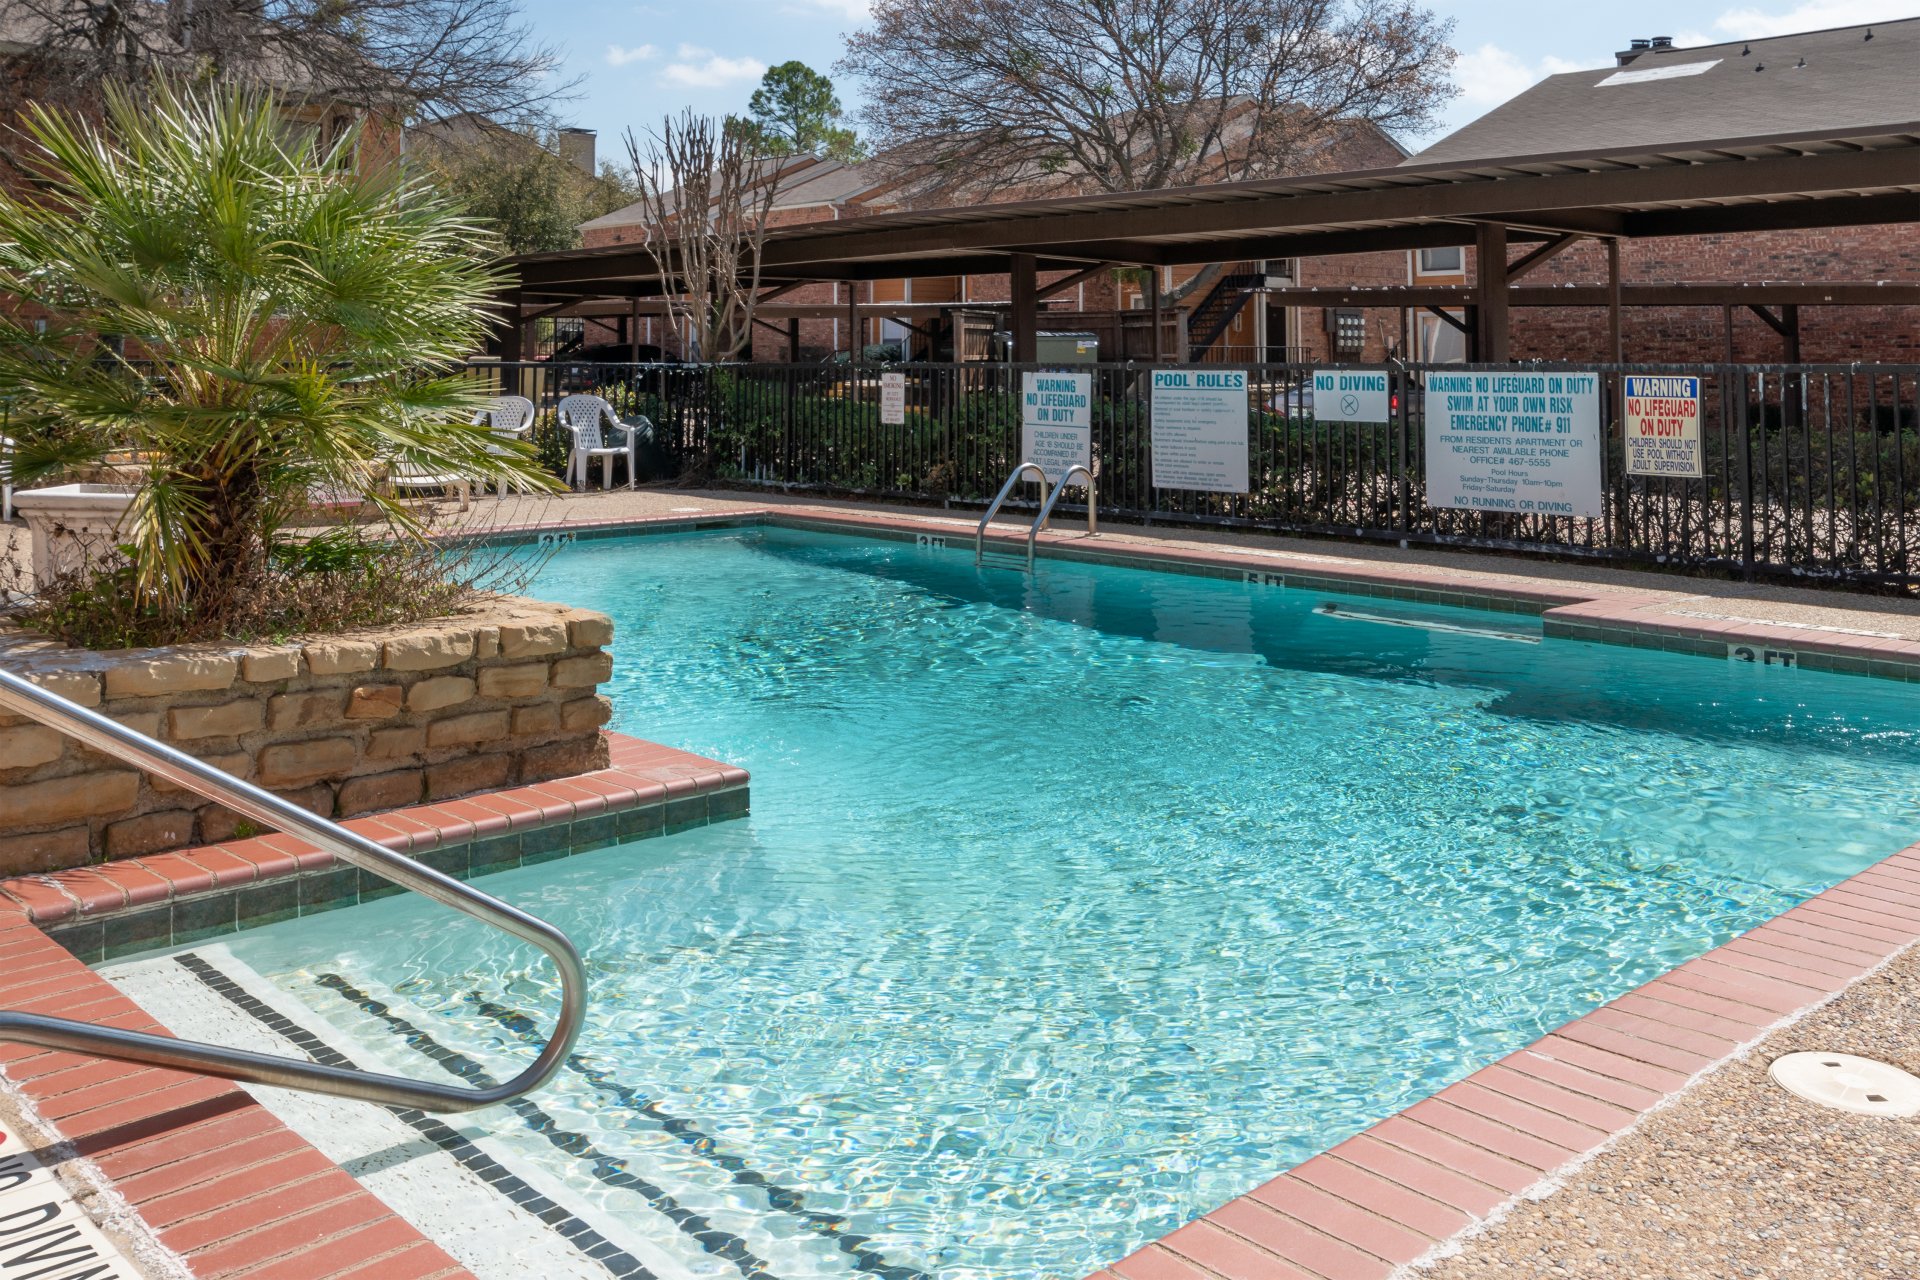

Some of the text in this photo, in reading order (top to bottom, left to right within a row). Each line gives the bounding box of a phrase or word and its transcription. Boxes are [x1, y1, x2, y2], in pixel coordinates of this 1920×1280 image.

[1036, 379, 1076, 392] WARNING
[1155, 374, 1243, 388] POOL RULES
[1316, 376, 1385, 391] NO DIVING
[1429, 376, 1594, 394] WARNING NO LIFEGUARD ON DUTY
[1632, 378, 1691, 398] WARNING
[1026, 392, 1086, 408] NO LIFEGUARD
[1448, 396, 1574, 414] SWIM AT YOUR OWN RISK
[1037, 408, 1074, 422] ON DUTY
[1628, 399, 1696, 418] NO LIFEGUARD
[1450, 414, 1571, 434] EMERGENCY PHONE# 911
[1640, 418, 1684, 437] ON DUTY
[1034, 431, 1078, 440] CHILDREN UNDER
[1440, 436, 1583, 448] FROM RESIDENTS APARTMENT OR
[1628, 437, 1696, 450] CHILDREN SHOULD NOT
[1033, 449, 1070, 458] ACCOMPANIED
[1452, 446, 1570, 458] NEAREST AVAILABLE PHONE
[1632, 448, 1694, 461] USE POOL WITHOUT
[1470, 456, 1551, 467] OFFICE# 467-5555
[1632, 460, 1695, 472] ADULT SUPERVISION
[1459, 475, 1563, 488] Sunday-Thursday 10am-10pm
[1462, 484, 1516, 494] Friday-Saturday
[1454, 496, 1572, 512] NO RUNNING OR DIVING
